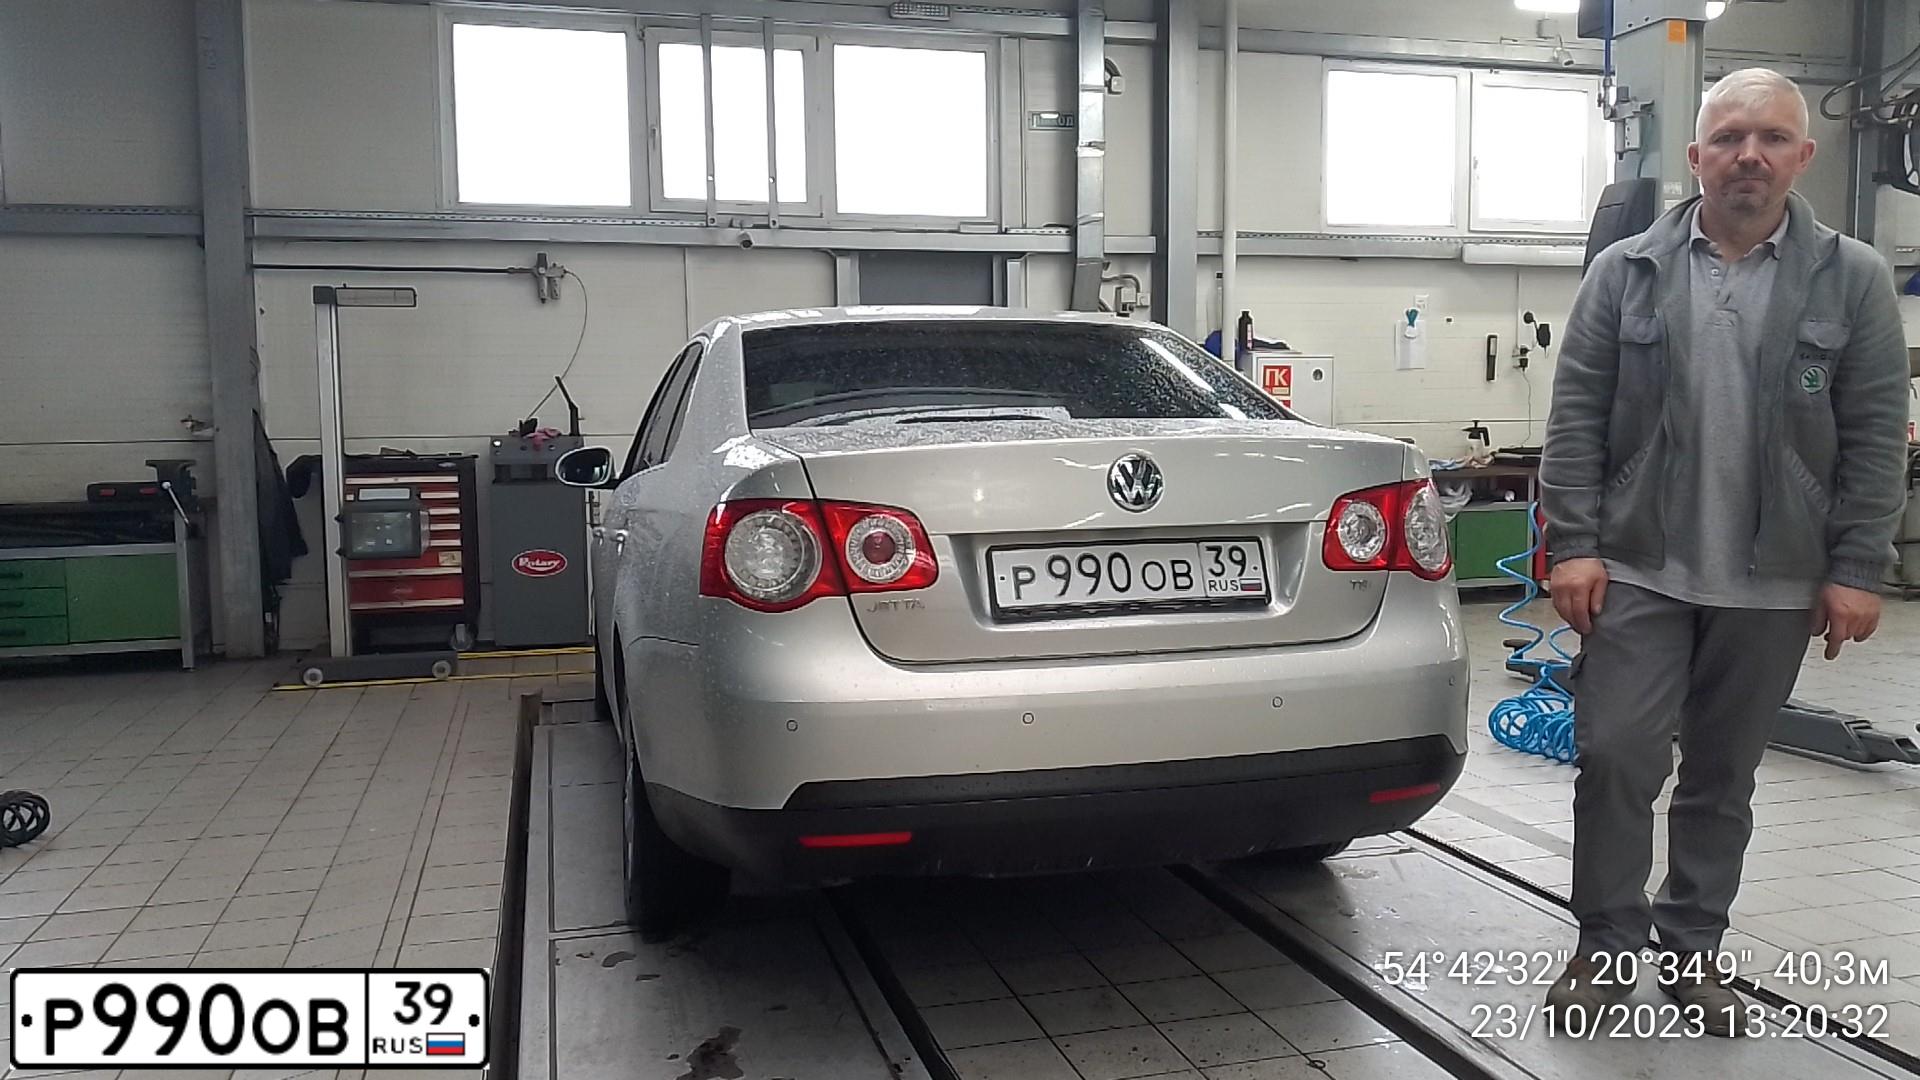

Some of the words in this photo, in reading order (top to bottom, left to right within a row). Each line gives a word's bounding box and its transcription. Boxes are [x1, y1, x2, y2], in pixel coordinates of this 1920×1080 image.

[1265, 368, 1289, 387] ПК
[1205, 545, 1247, 578] 39
[1208, 579, 1239, 592] RUS
[866, 598, 925, 613] JETTA
